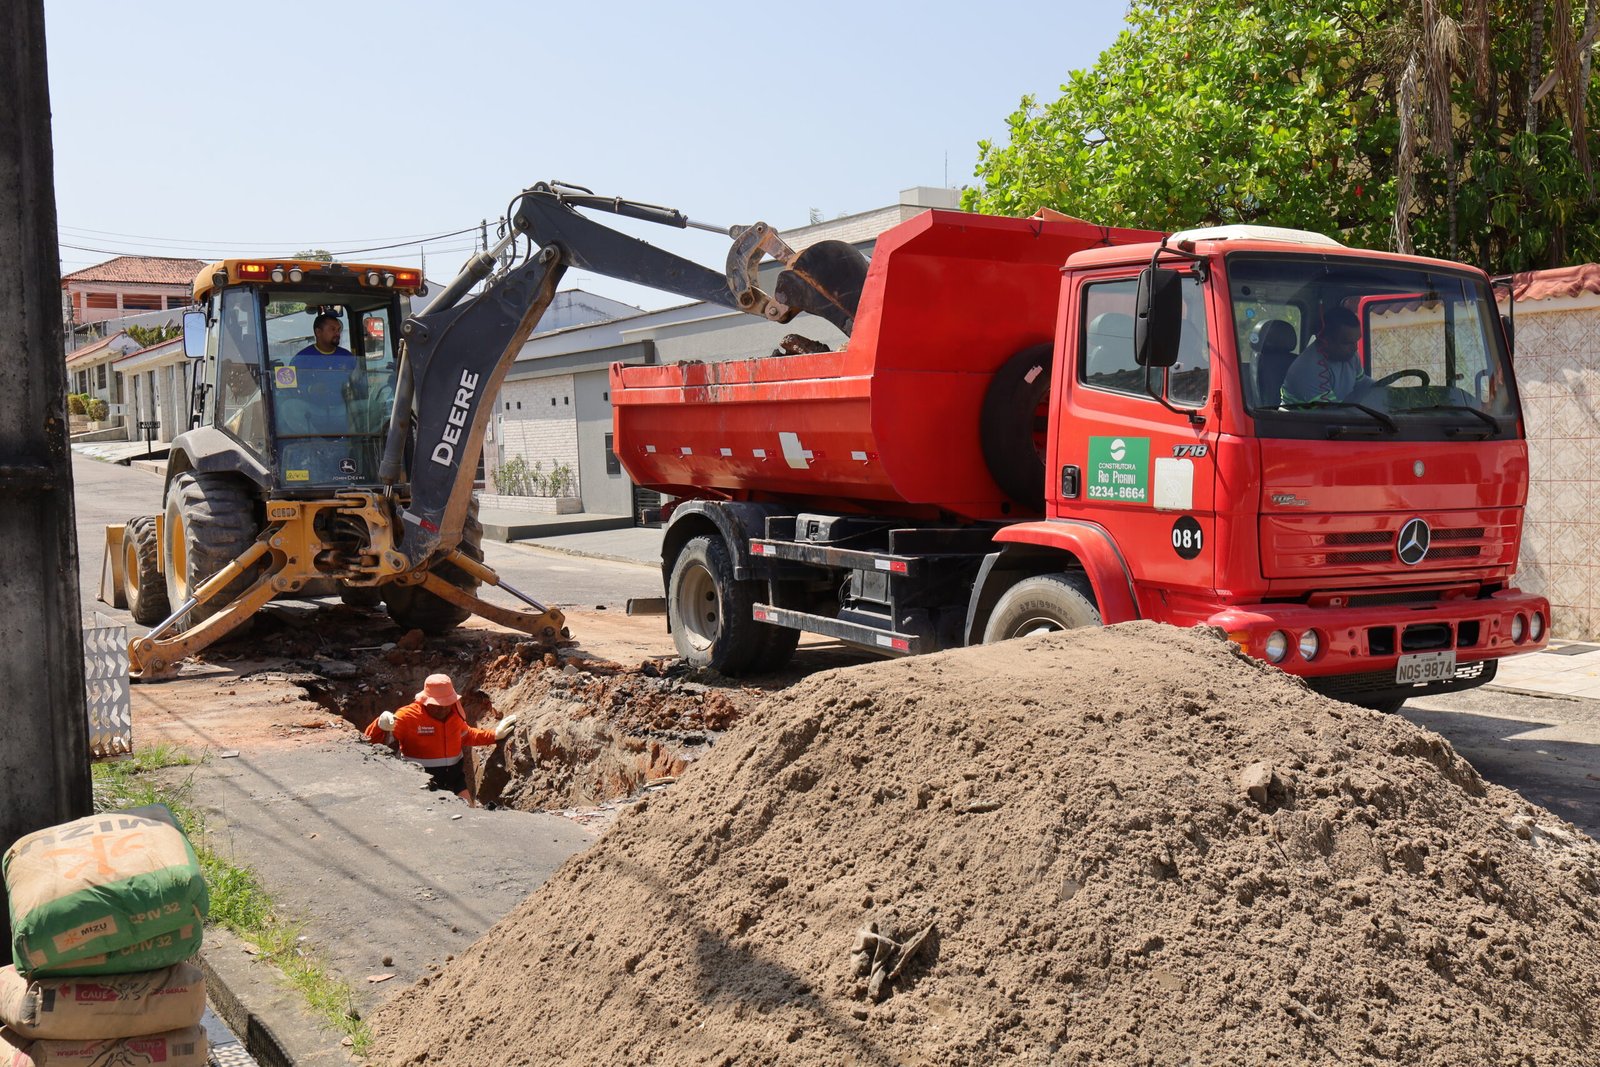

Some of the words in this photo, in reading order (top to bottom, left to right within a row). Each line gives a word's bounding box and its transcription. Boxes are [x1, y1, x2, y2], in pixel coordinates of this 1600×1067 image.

[431, 369, 479, 467] DEERE
[1172, 445, 1208, 457] 1718
[1098, 462, 1136, 470] CONSTRUTORA
[1089, 486, 1145, 499] 3234-8664
[1172, 529, 1202, 549] 081
[148, 909, 161, 921] IV
[163, 902, 181, 915] 32
[81, 922, 107, 936] MIZU
[157, 935, 172, 948] 32
